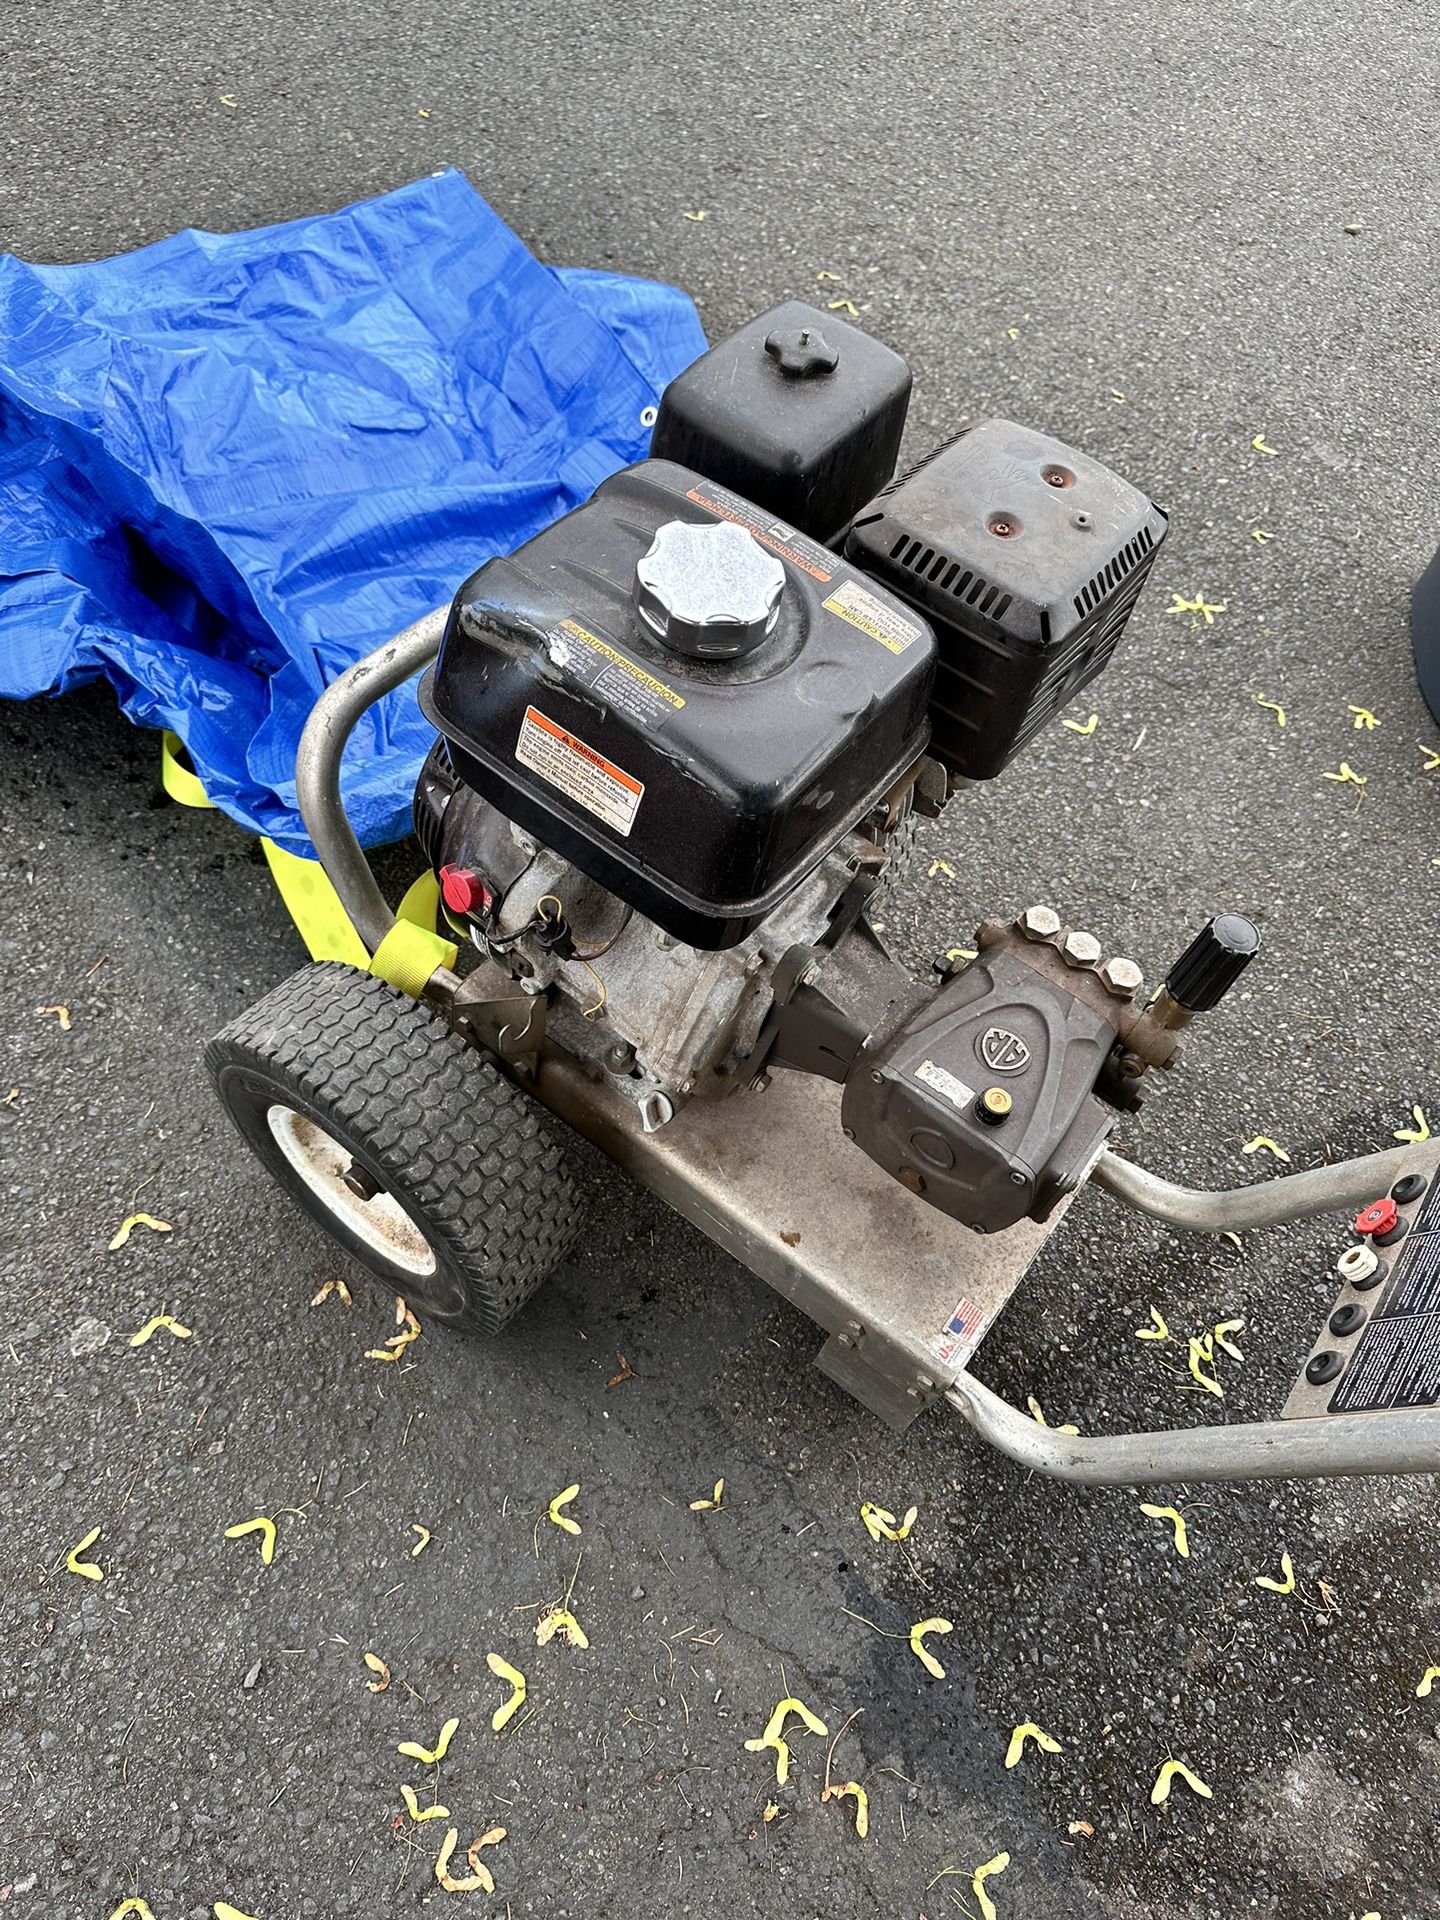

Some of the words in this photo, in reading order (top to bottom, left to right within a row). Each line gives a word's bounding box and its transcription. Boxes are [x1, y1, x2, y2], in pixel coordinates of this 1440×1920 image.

[841, 608, 877, 635] CAUTION
[847, 603, 863, 615] CAN
[571, 740, 605, 768] WARNING
